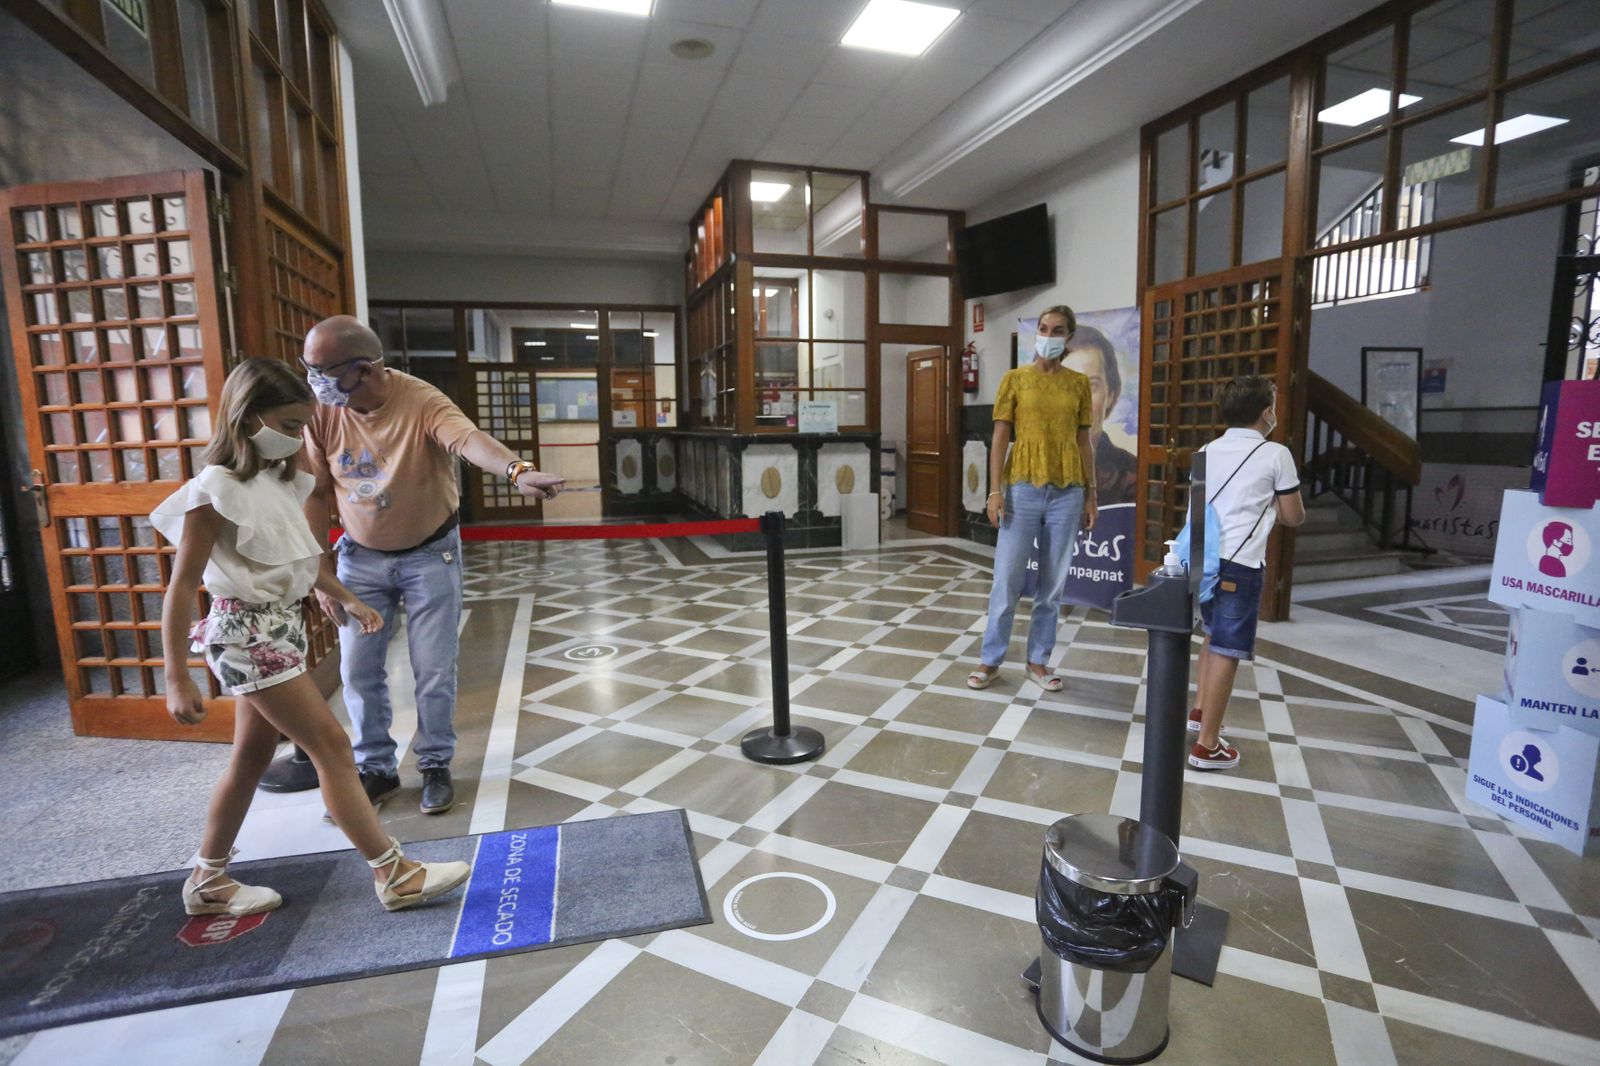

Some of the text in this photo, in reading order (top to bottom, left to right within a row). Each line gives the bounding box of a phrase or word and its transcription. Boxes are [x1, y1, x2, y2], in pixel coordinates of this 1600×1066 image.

[1502, 576, 1523, 590] USA
[1520, 698, 1600, 720] MANTEN LA
[1473, 774, 1580, 831] SIGUE LAS INDICACIONES
[1491, 793, 1554, 831] DEL PERSONAL
[491, 832, 528, 946] ZONA DE SECADO
